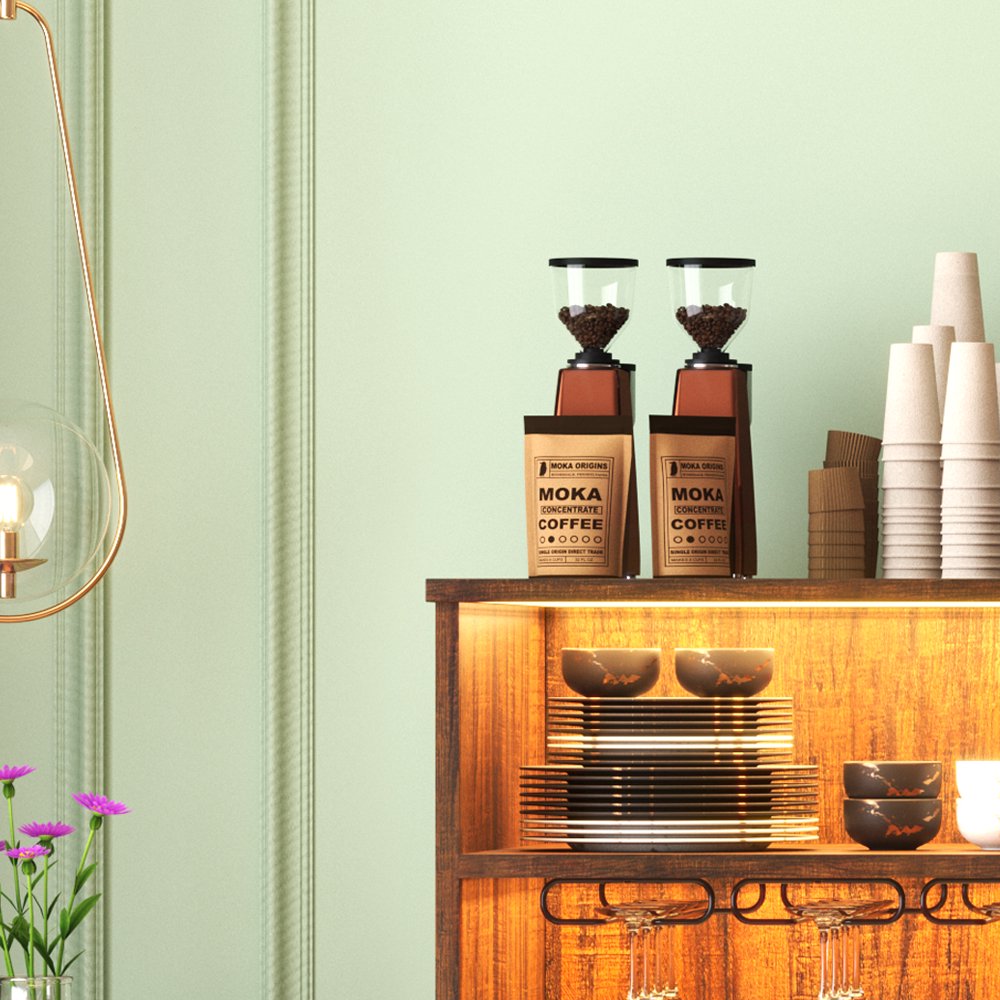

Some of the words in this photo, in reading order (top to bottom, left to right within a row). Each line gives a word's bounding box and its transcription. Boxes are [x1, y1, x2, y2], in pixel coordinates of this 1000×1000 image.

[539, 487, 602, 501] MOKA
[672, 487, 724, 501] MOKA
[538, 518, 603, 530] COFFEE
[671, 518, 727, 530] COFFEE
